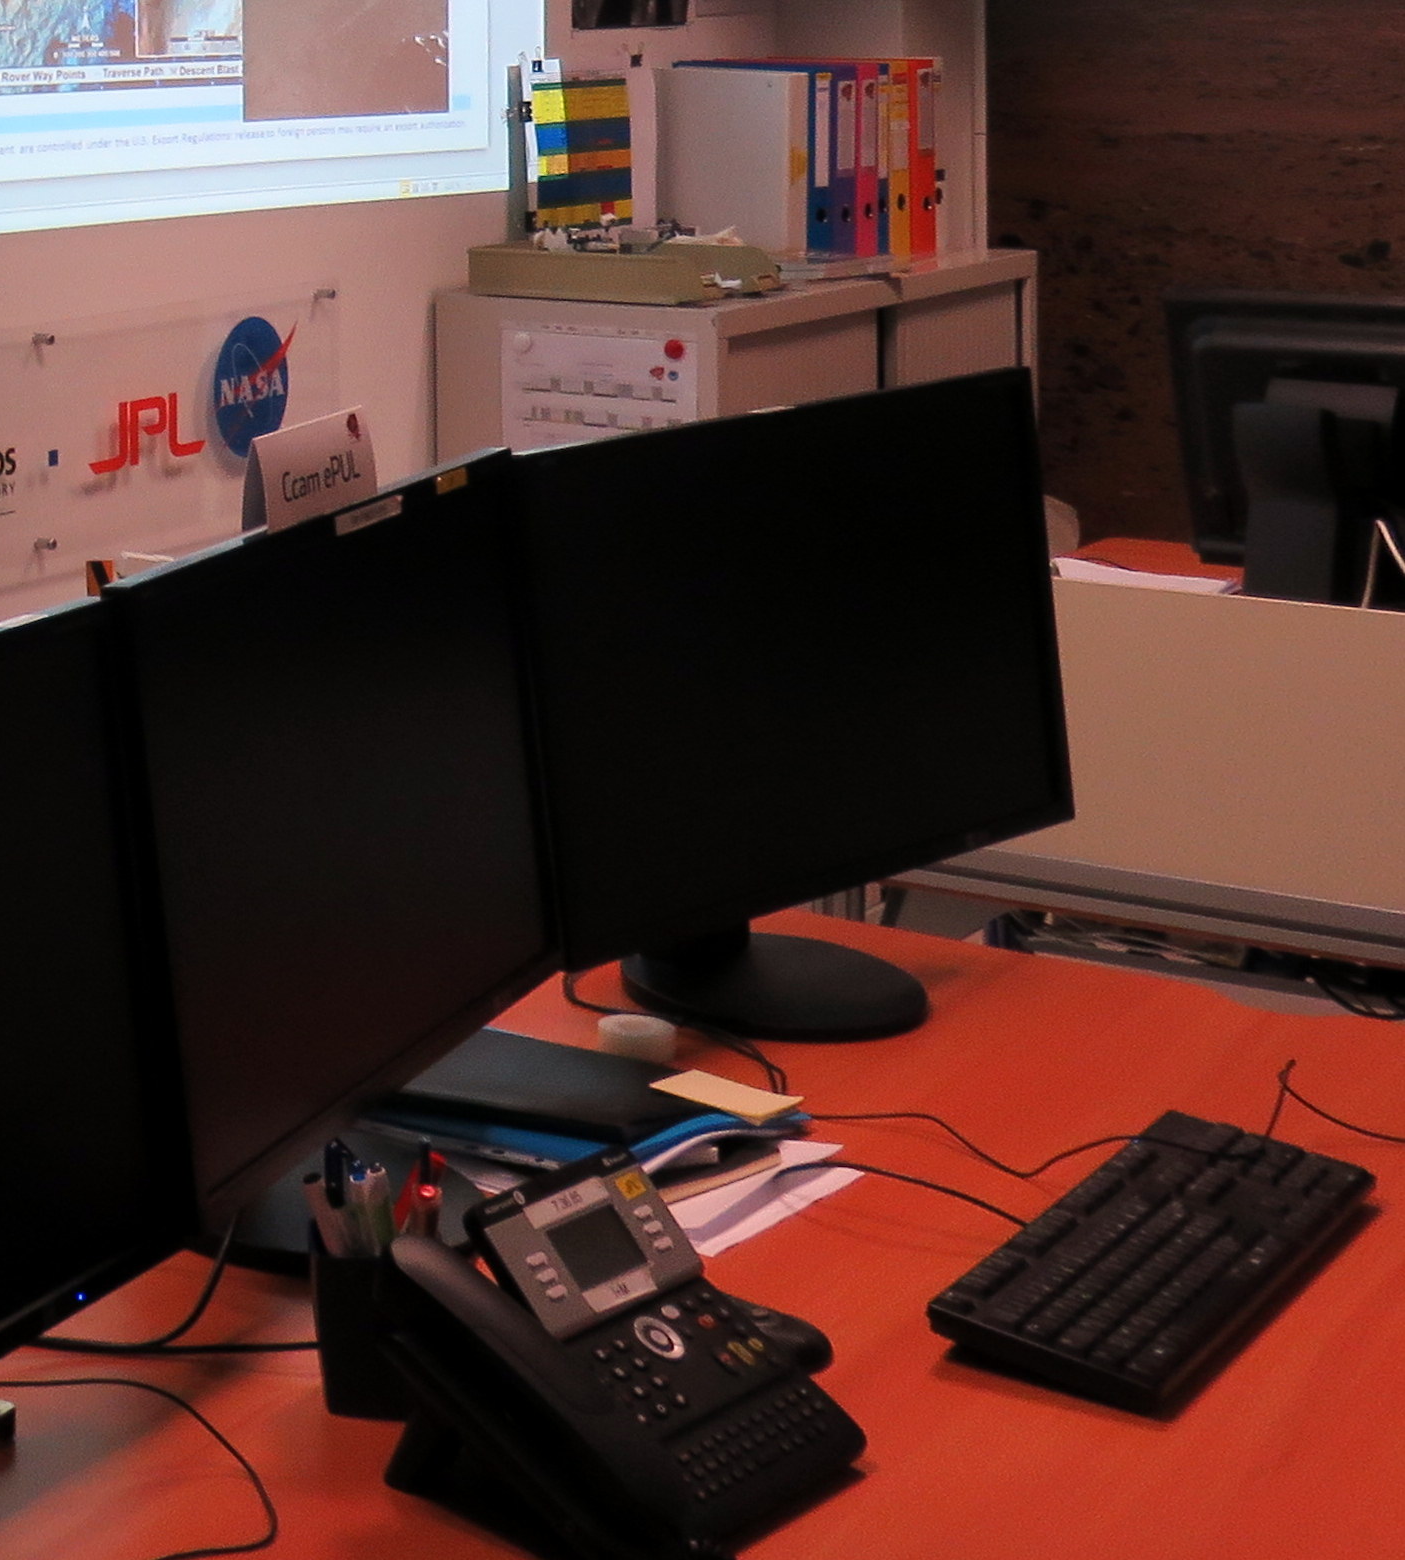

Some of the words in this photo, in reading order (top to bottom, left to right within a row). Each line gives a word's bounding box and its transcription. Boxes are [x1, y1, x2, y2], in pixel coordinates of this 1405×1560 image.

[1, 71, 32, 83] Rover
[33, 71, 54, 84] Way
[56, 69, 86, 82] Points
[103, 67, 141, 79] Traverse
[144, 66, 164, 77] Path
[179, 64, 214, 76] Descent
[217, 64, 239, 75] Blast
[37, 141, 83, 153] controlled
[151, 134, 180, 146] Export
[220, 368, 286, 407] NASA
[89, 393, 206, 475] JPL
[282, 470, 322, 502] Ccam
[323, 448, 362, 494] ePUL
